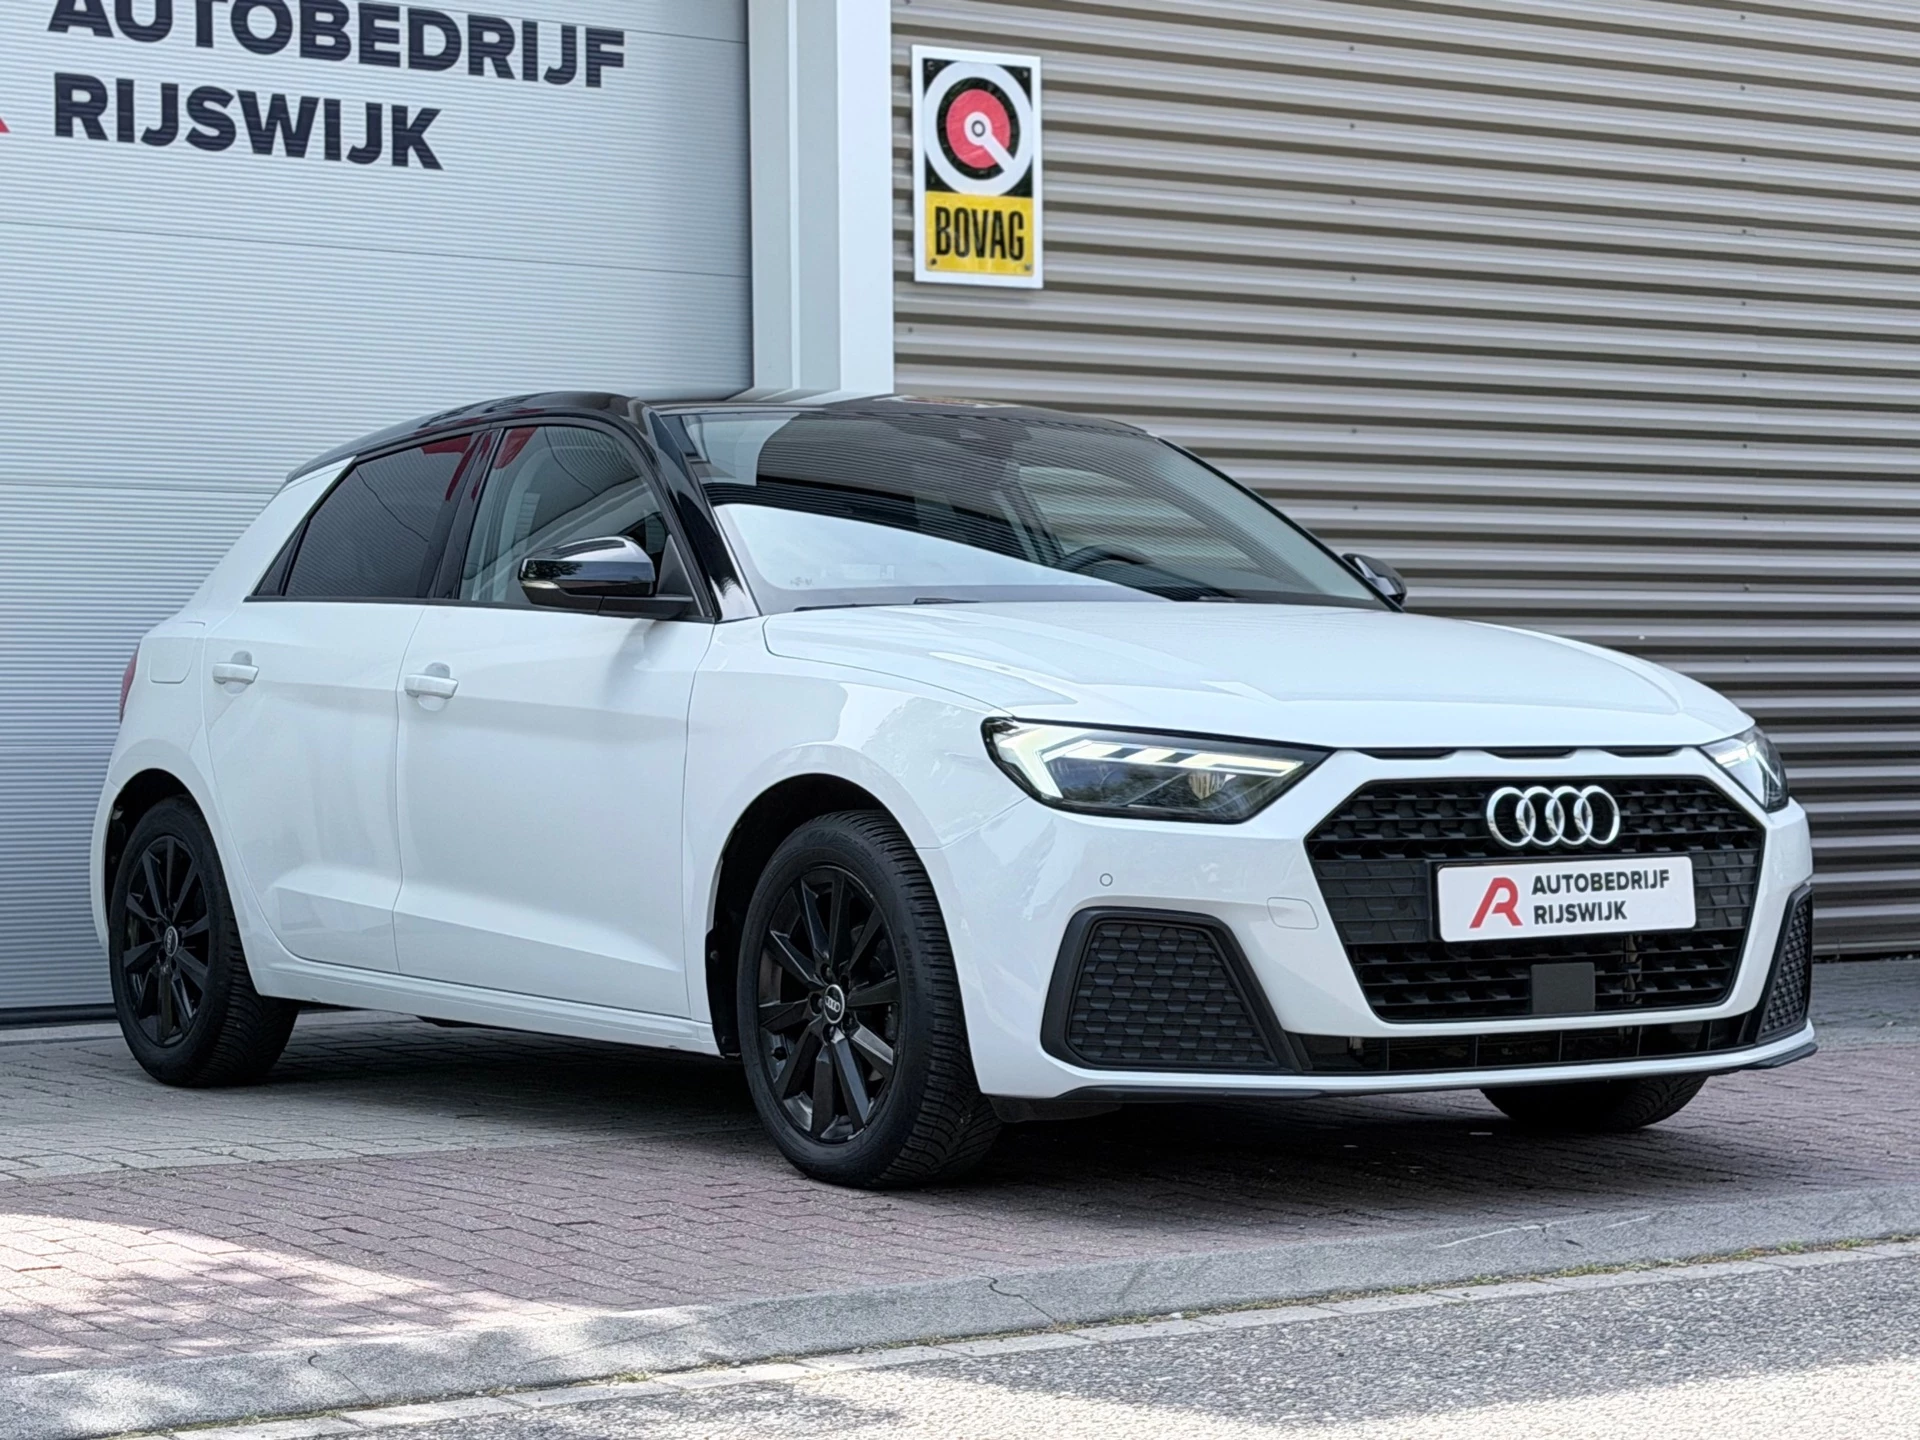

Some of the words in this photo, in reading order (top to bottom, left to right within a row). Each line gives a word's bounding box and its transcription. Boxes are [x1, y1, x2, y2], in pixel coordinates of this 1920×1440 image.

[47, 0, 625, 88] AUTOBEDRIJF
[54, 72, 443, 171] RIJSWIJK
[935, 206, 1025, 261] BOVAG
[1532, 869, 1670, 895] AUTOBEDRIJF
[1533, 901, 1627, 925] RIJSWIJK
